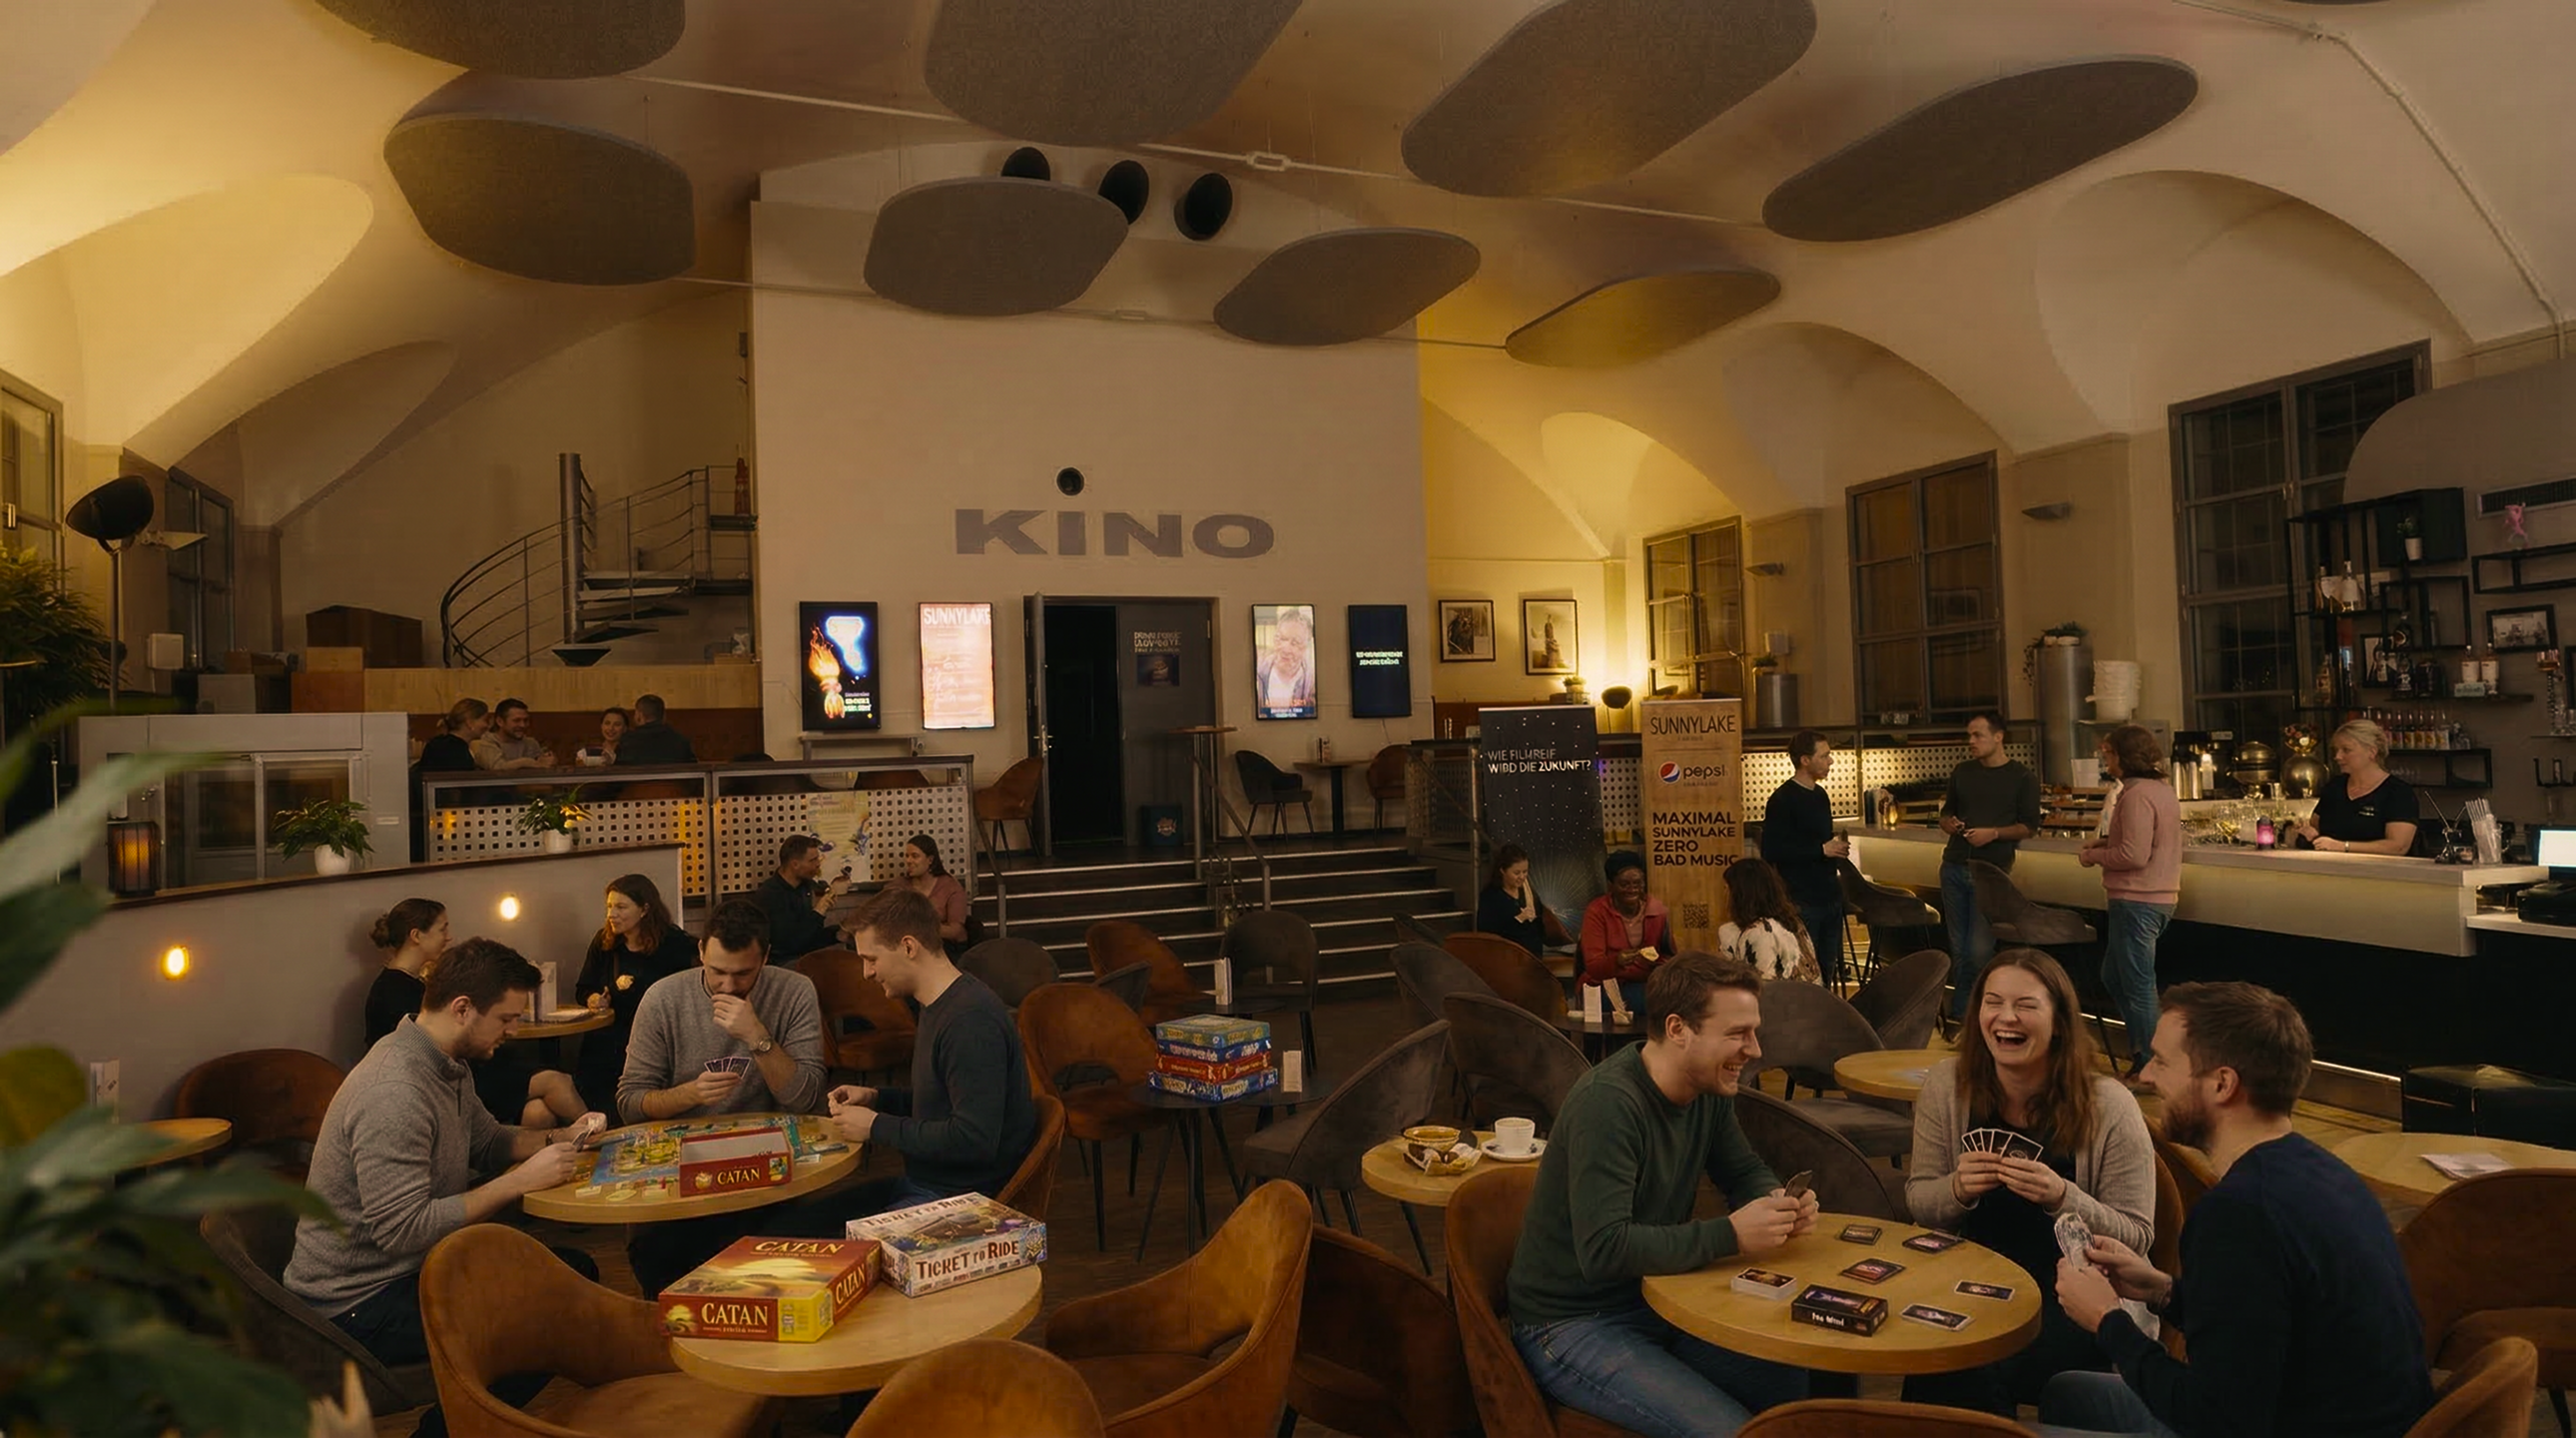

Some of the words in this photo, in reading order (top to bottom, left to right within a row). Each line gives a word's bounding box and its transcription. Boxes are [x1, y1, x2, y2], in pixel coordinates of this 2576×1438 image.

[956, 508, 1275, 558] KINO
[1649, 715, 1736, 735] SUNNYLAKE
[1488, 750, 1508, 761] WIE
[1519, 761, 1538, 773] DIE
[1652, 812, 1736, 825] MAXIMAL
[1652, 827, 1736, 838] SUNNYLAKE
[1653, 840, 1698, 853] ZERO
[1654, 855, 1686, 867] BAD
[1690, 854, 1739, 867] MUSIC
[716, 1167, 762, 1185] CATAN
[755, 1241, 844, 1254] CATAN
[987, 1240, 1020, 1260] RIDE
[835, 1263, 867, 1306] CATAN
[701, 1302, 769, 1326] CATAN
